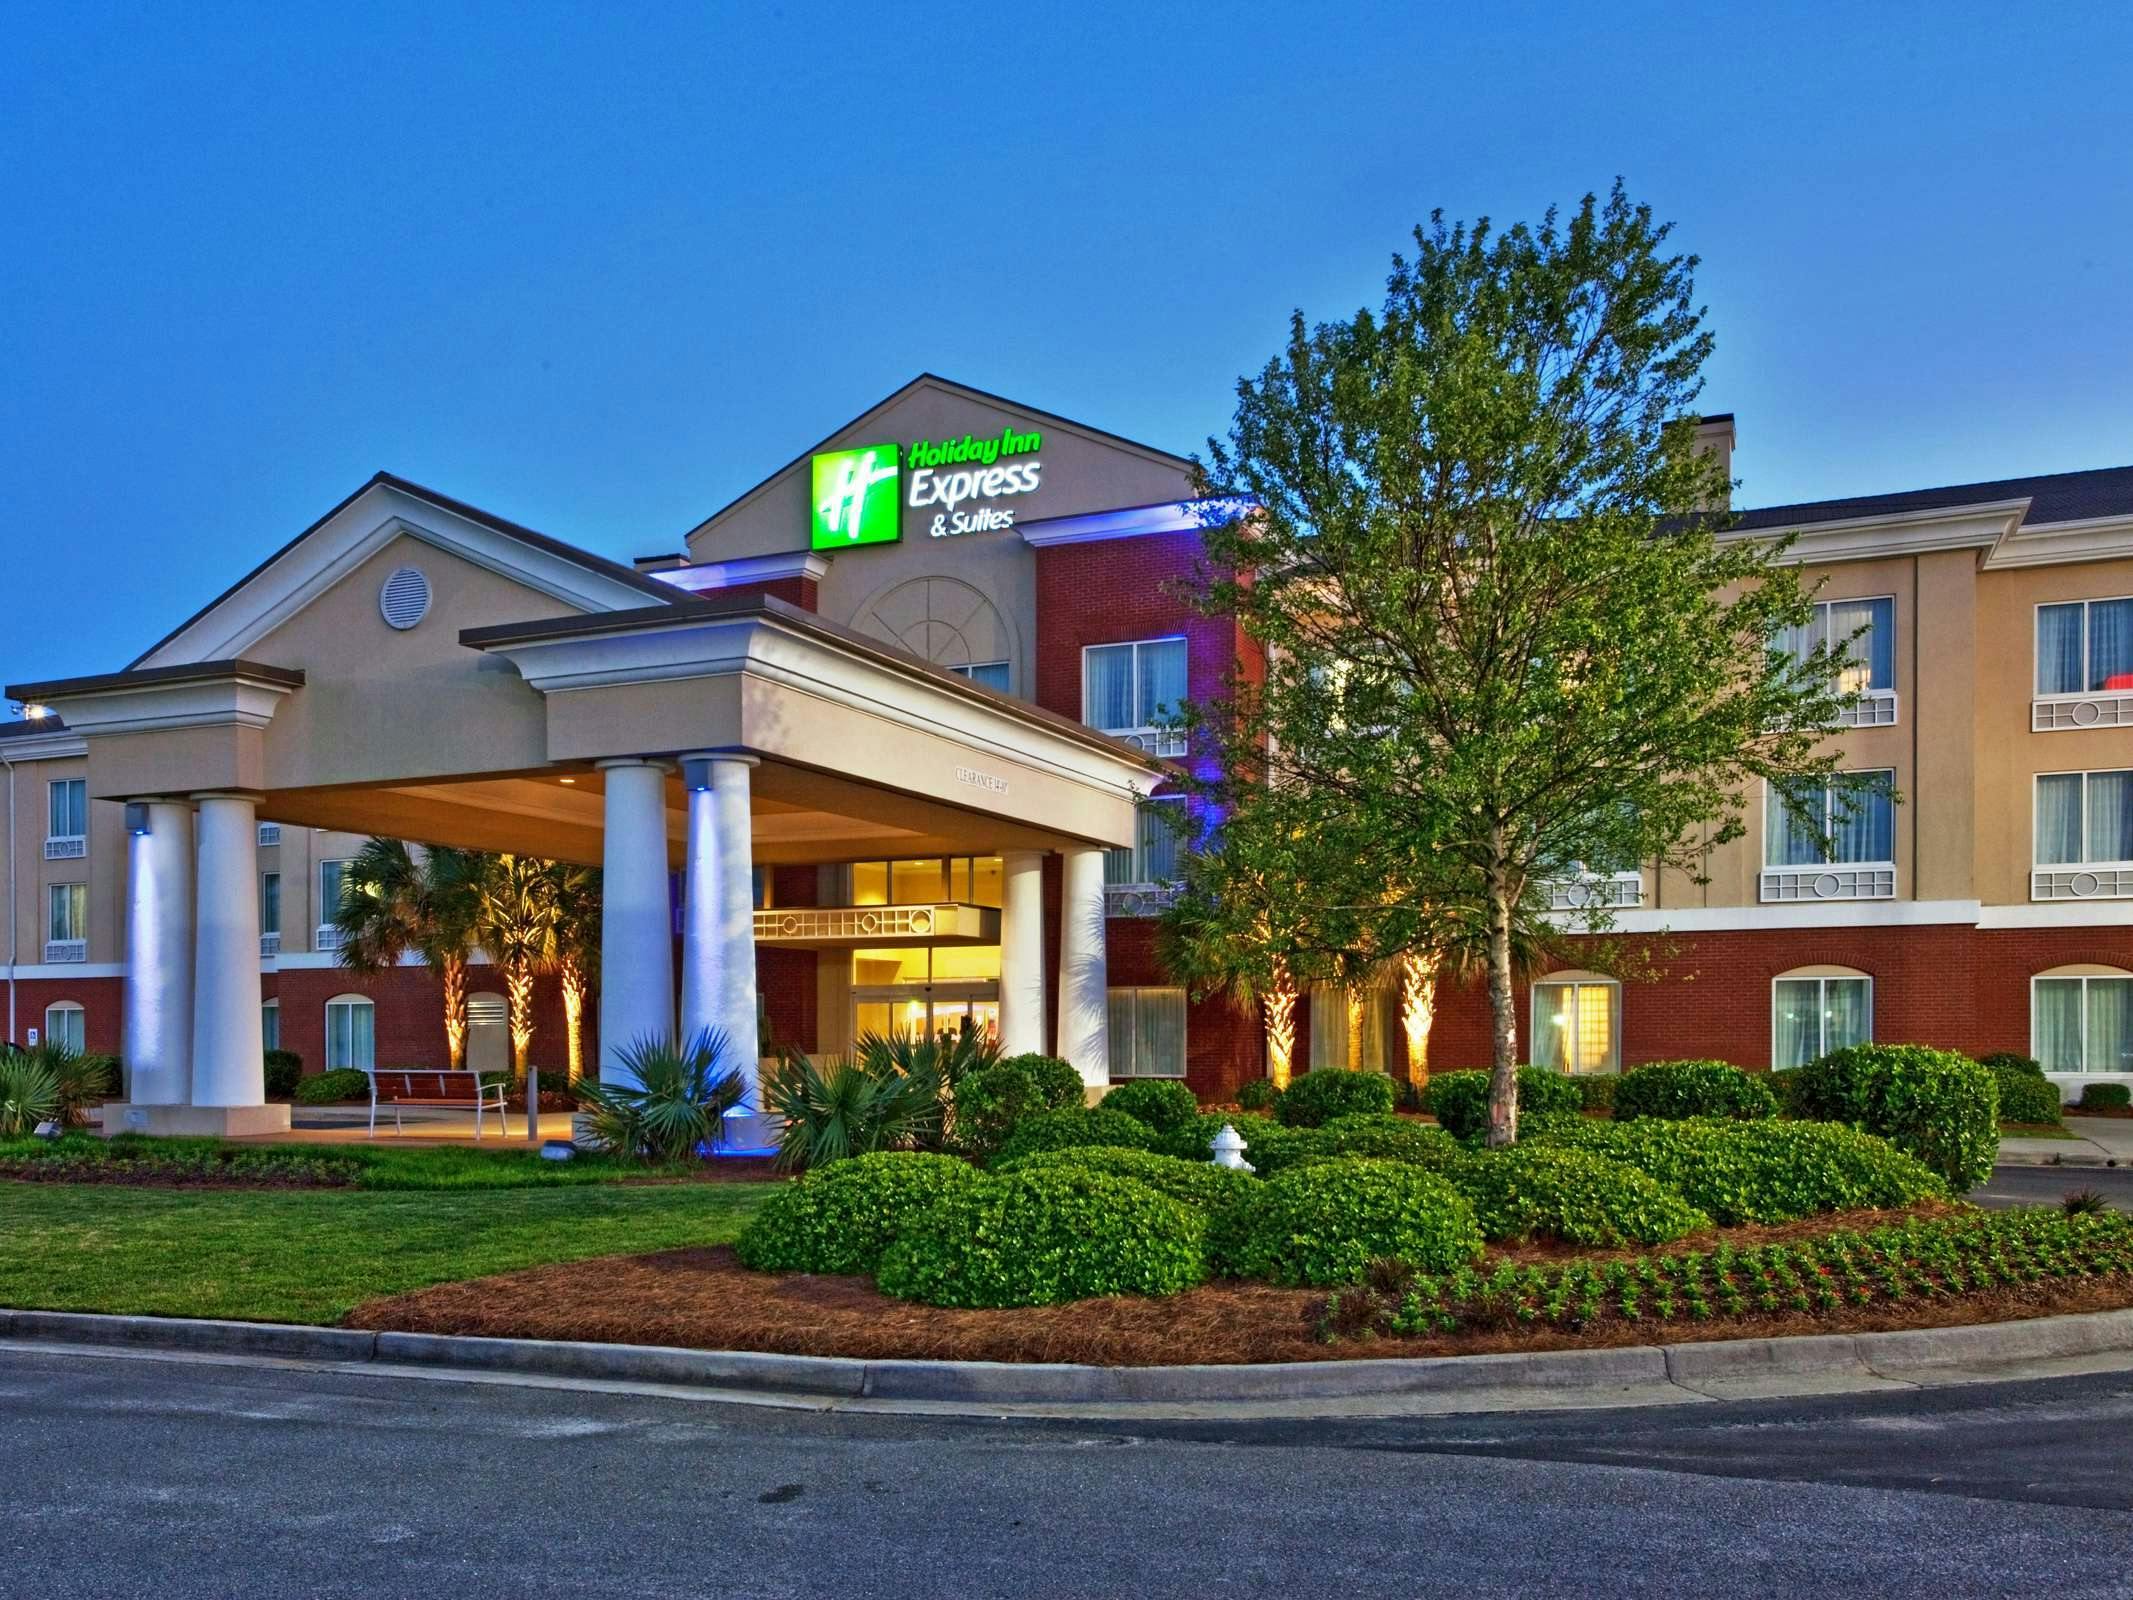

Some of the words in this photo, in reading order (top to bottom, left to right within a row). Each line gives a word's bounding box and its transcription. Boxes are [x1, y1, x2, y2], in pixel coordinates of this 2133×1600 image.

[908, 435, 999, 468] Holiday
[1000, 427, 1041, 455] Inn
[908, 461, 1041, 511] Express
[930, 514, 949, 537] &
[950, 509, 1015, 534] Suites
